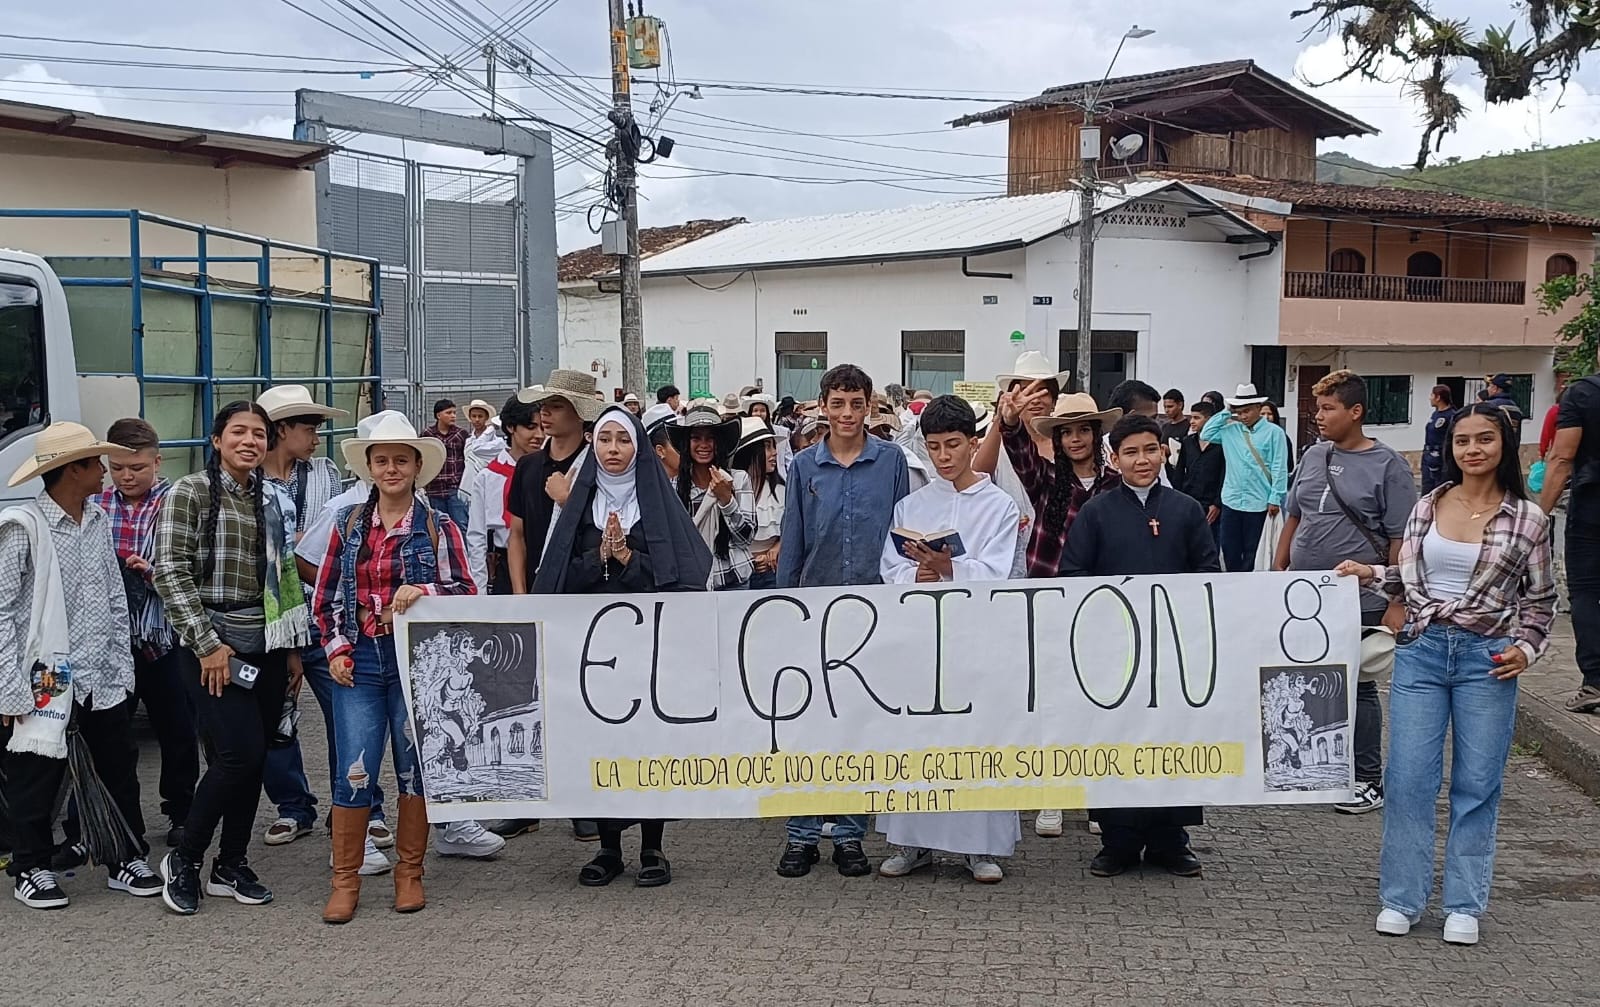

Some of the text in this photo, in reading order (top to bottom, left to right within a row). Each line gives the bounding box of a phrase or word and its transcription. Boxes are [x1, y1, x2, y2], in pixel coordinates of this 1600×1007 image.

[580, 576, 1217, 754] EL GRITÓN
[596, 760, 621, 788] LA
[637, 758, 729, 787] LEYENDA
[737, 756, 776, 788] QUE
[784, 755, 814, 784] NO
[822, 754, 875, 782] CESA
[884, 753, 911, 780] DE
[922, 751, 1008, 782] GRITAR
[1015, 749, 1044, 779] SU
[1052, 747, 1125, 778] DOLOR
